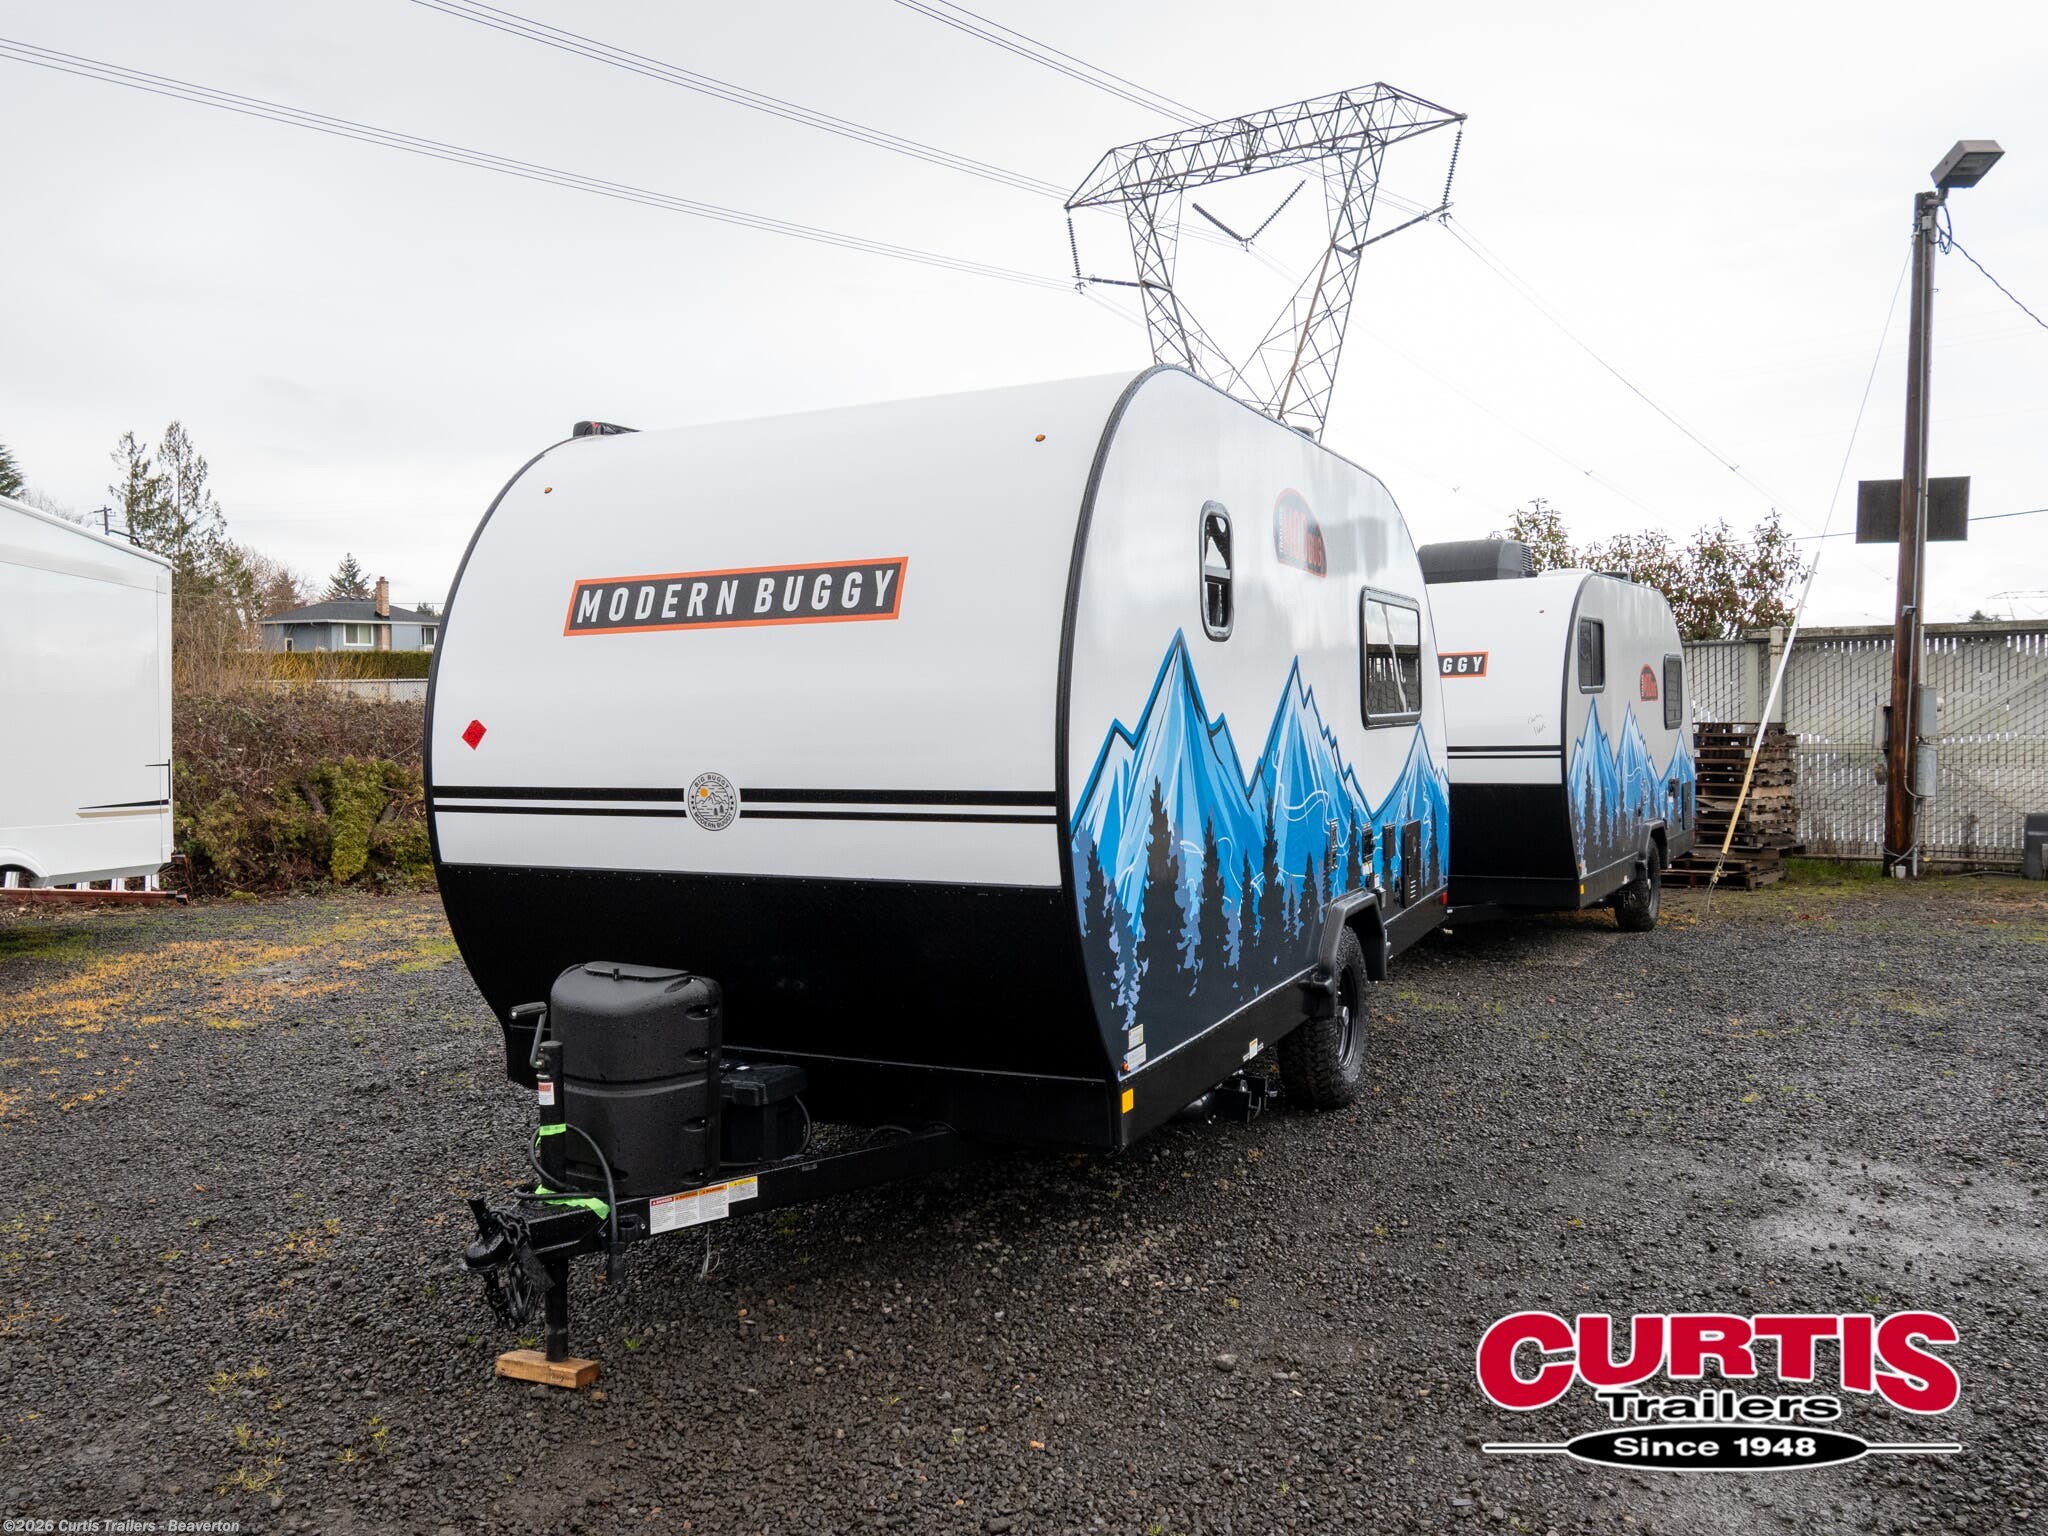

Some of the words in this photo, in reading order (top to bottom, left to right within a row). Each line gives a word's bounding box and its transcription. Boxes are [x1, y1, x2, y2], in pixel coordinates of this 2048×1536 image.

[576, 579, 739, 624] MODERN
[753, 568, 895, 614] BUGGY
[1442, 656, 1483, 673] GGY
[694, 776, 706, 788] BIG
[707, 774, 730, 789] BUGGY
